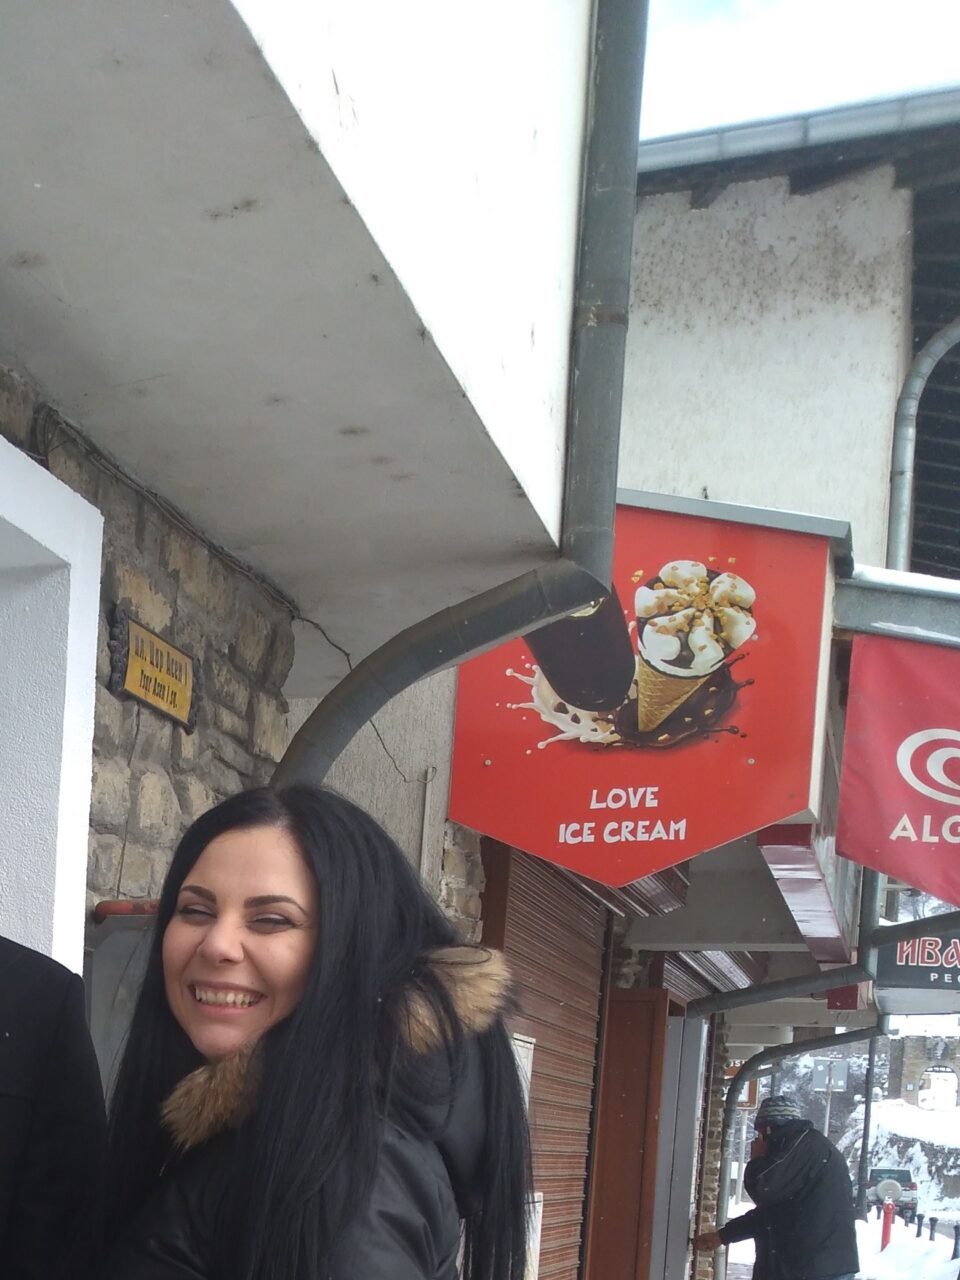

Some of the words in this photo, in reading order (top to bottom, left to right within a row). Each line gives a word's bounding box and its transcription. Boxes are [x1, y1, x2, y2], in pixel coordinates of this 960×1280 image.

[589, 786, 659, 809] LOVE
[558, 822, 596, 844] ICE
[603, 818, 687, 843] CREAM
[930, 972, 960, 983] РЕ
